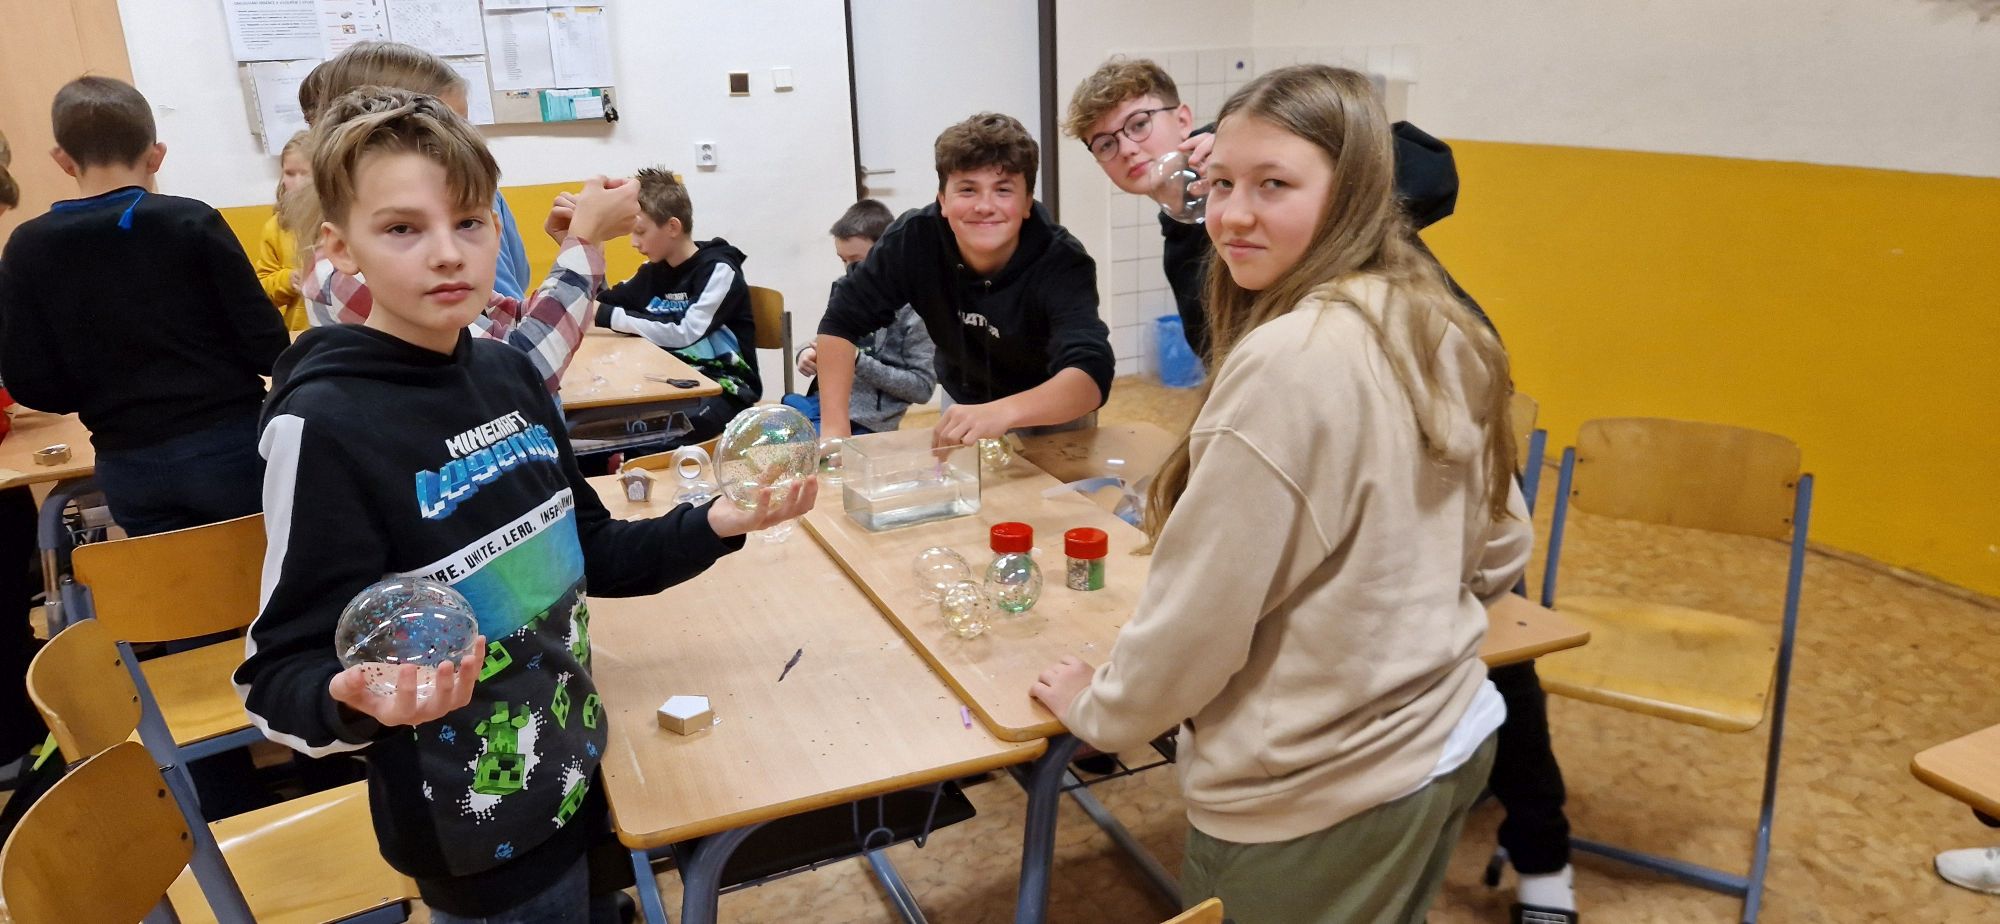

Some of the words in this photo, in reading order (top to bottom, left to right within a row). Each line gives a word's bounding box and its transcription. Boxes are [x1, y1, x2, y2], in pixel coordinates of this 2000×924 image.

[445, 410, 528, 458] MINECRAFT
[415, 423, 559, 520] LEGENDS
[464, 541, 502, 569] UNITE.
[502, 521, 537, 547] LEAD.
